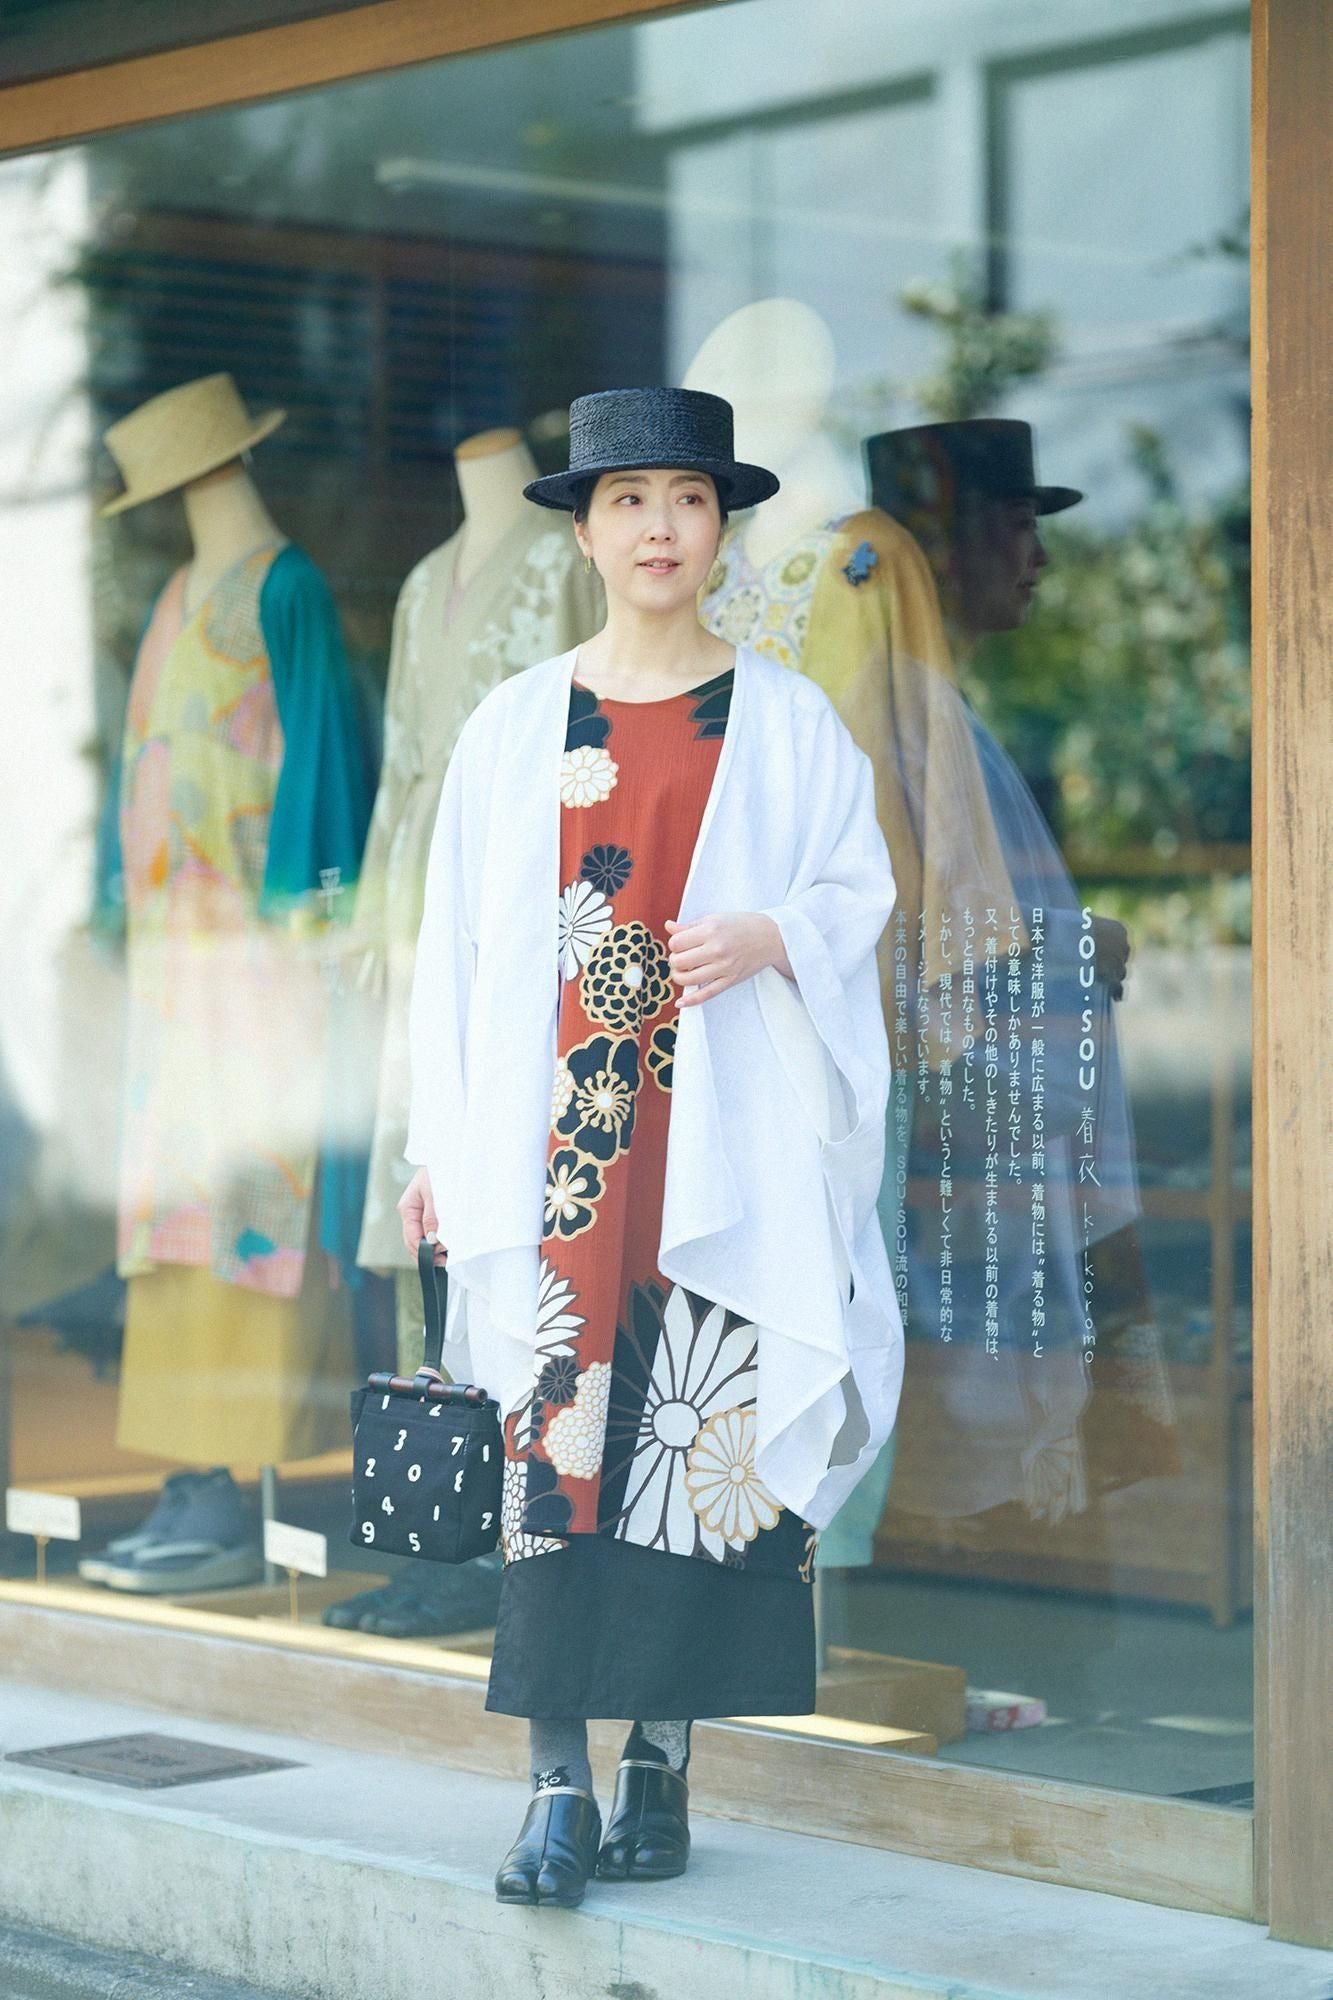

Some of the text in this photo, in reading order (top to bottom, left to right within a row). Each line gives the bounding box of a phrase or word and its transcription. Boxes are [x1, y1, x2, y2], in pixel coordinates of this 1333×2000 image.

[962, 906, 976, 1111] もっと自由なものでした。
[1008, 906, 1022, 1186] しての意味しかありませんでした。
[1076, 1106, 1102, 1188] 着衣
[393, 1429, 408, 1451] 3
[451, 1436, 464, 1457] 7
[365, 1457, 376, 1478] 2
[407, 1463, 422, 1483] 0
[381, 1496, 395, 1516] 4
[481, 1511, 493, 1531] 2
[361, 1521, 375, 1544] 9
[408, 1532, 421, 1552] 5
